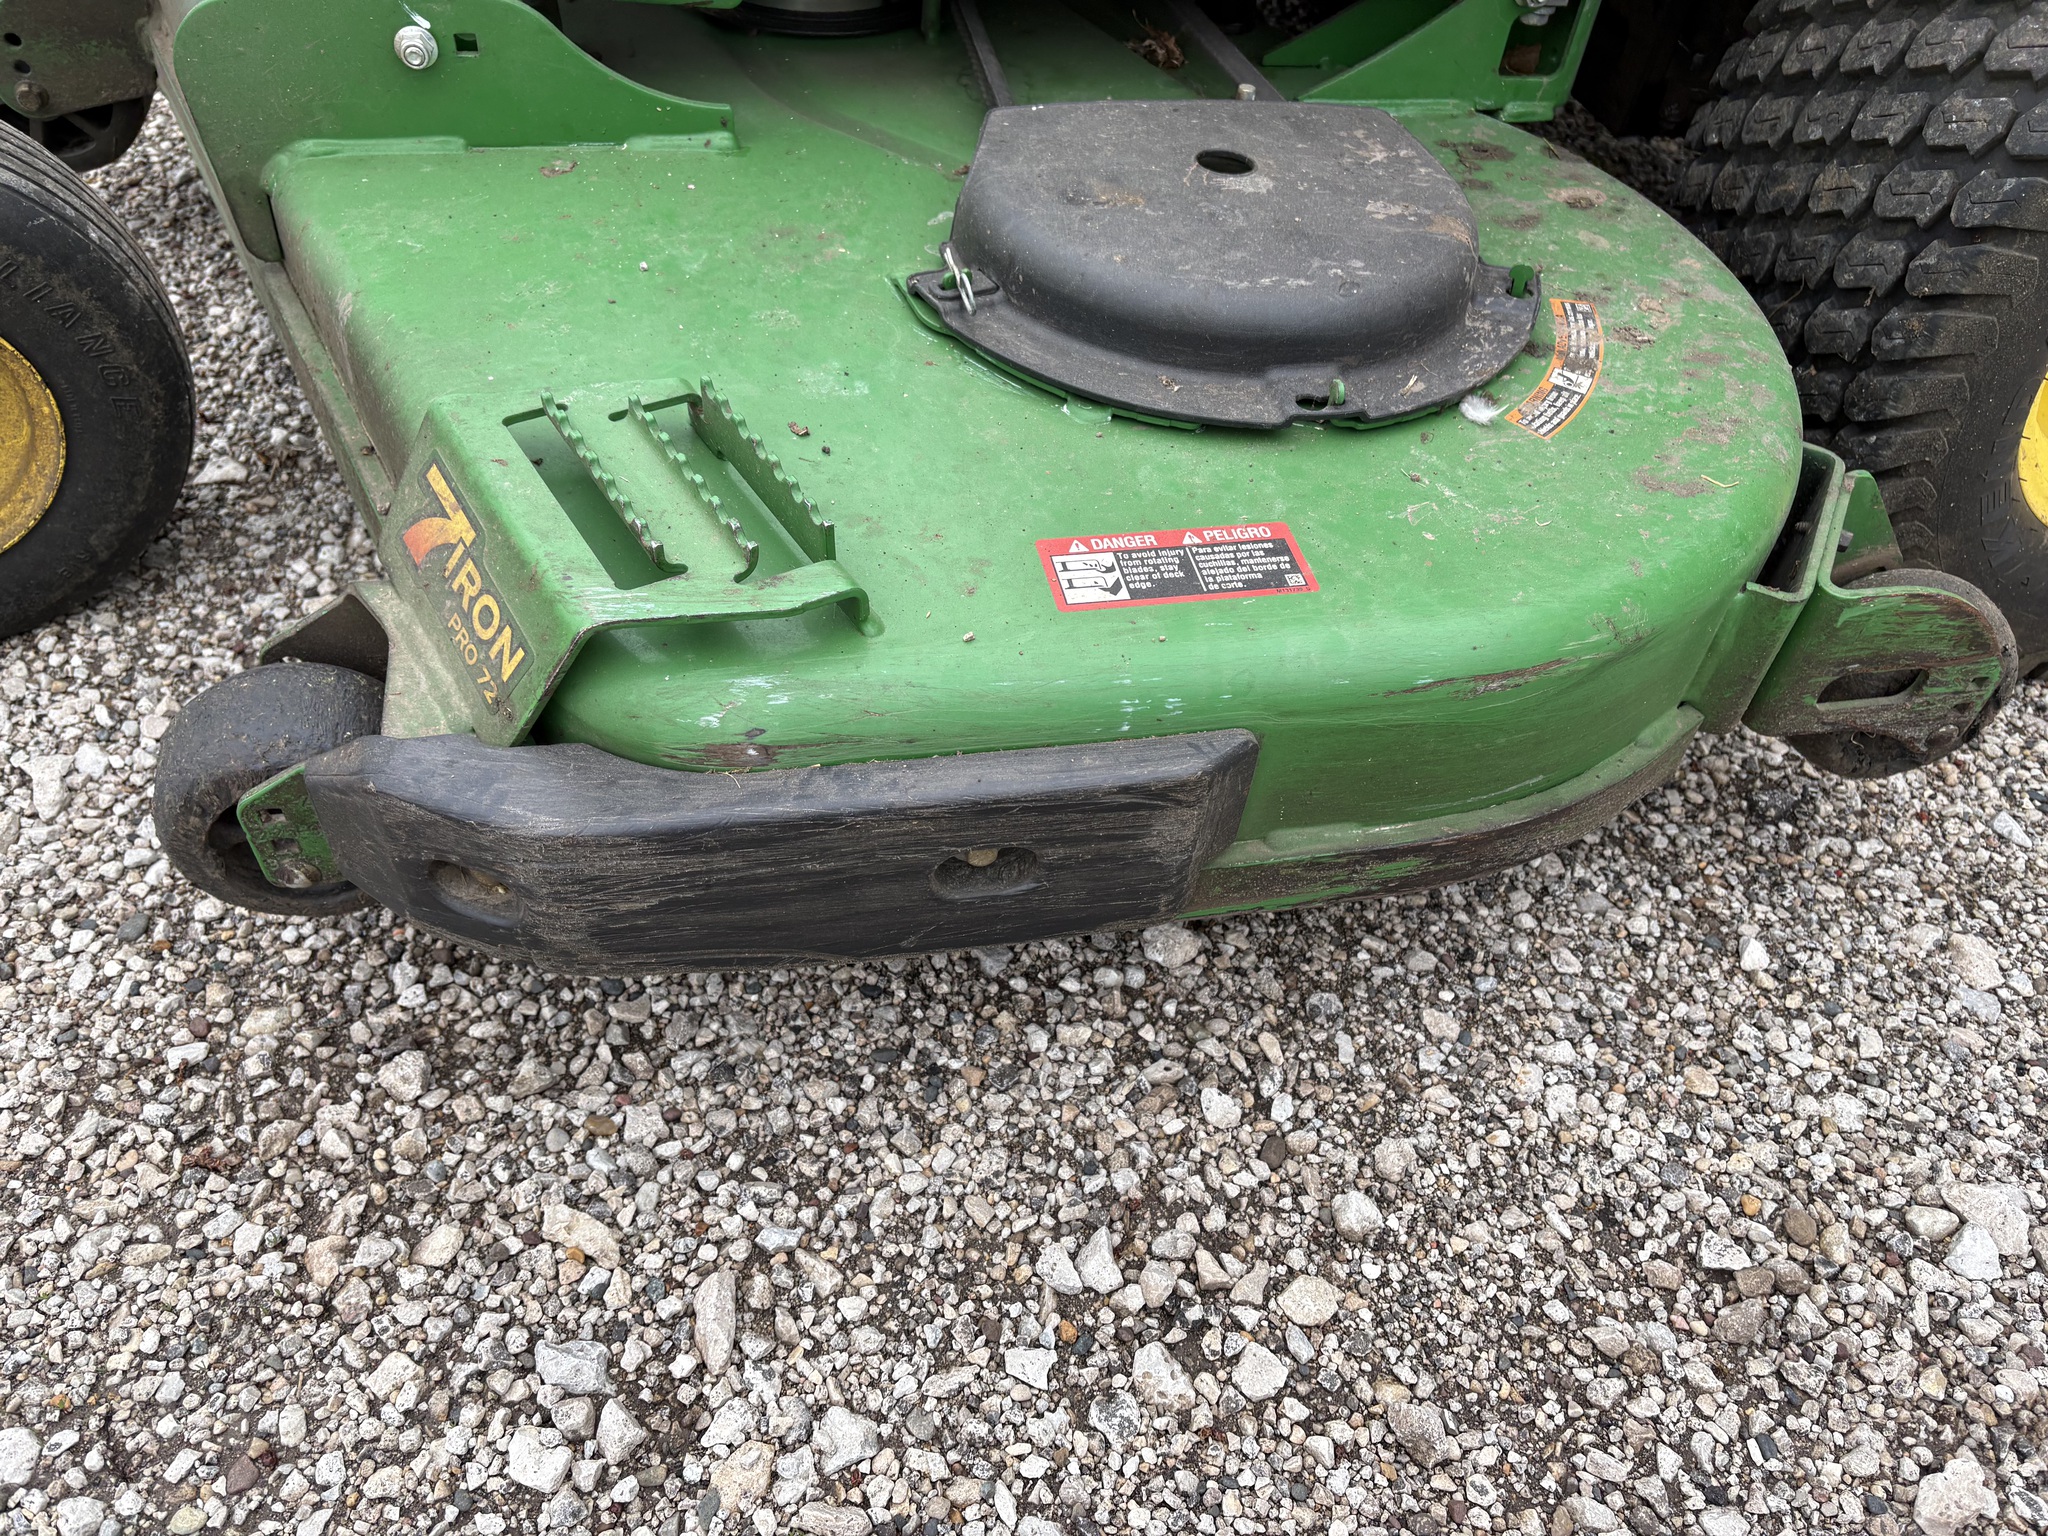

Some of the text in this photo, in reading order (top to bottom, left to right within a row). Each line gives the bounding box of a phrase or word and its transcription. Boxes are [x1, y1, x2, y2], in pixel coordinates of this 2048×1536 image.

[1090, 526, 1271, 550] DANGER PELIGRO
[1192, 542, 1273, 554] Para evitar lesiones
[1132, 550, 1156, 559] avoid
[1158, 548, 1184, 558] injury
[1195, 552, 1235, 561] causadas
[1144, 556, 1180, 566] rotating
[1241, 556, 1290, 565] mantenerse
[1159, 564, 1179, 573] stay
[1201, 568, 1235, 577] alejado
[1252, 564, 1278, 572] borde
[1280, 562, 1291, 570] de
[1126, 571, 1185, 581] clear of deck
[1215, 573, 1263, 582] plataforma
[1129, 581, 1156, 590] edge.
[1221, 582, 1246, 590] corte.
[444, 542, 525, 682] IRON
[448, 612, 499, 705] PRO 72
